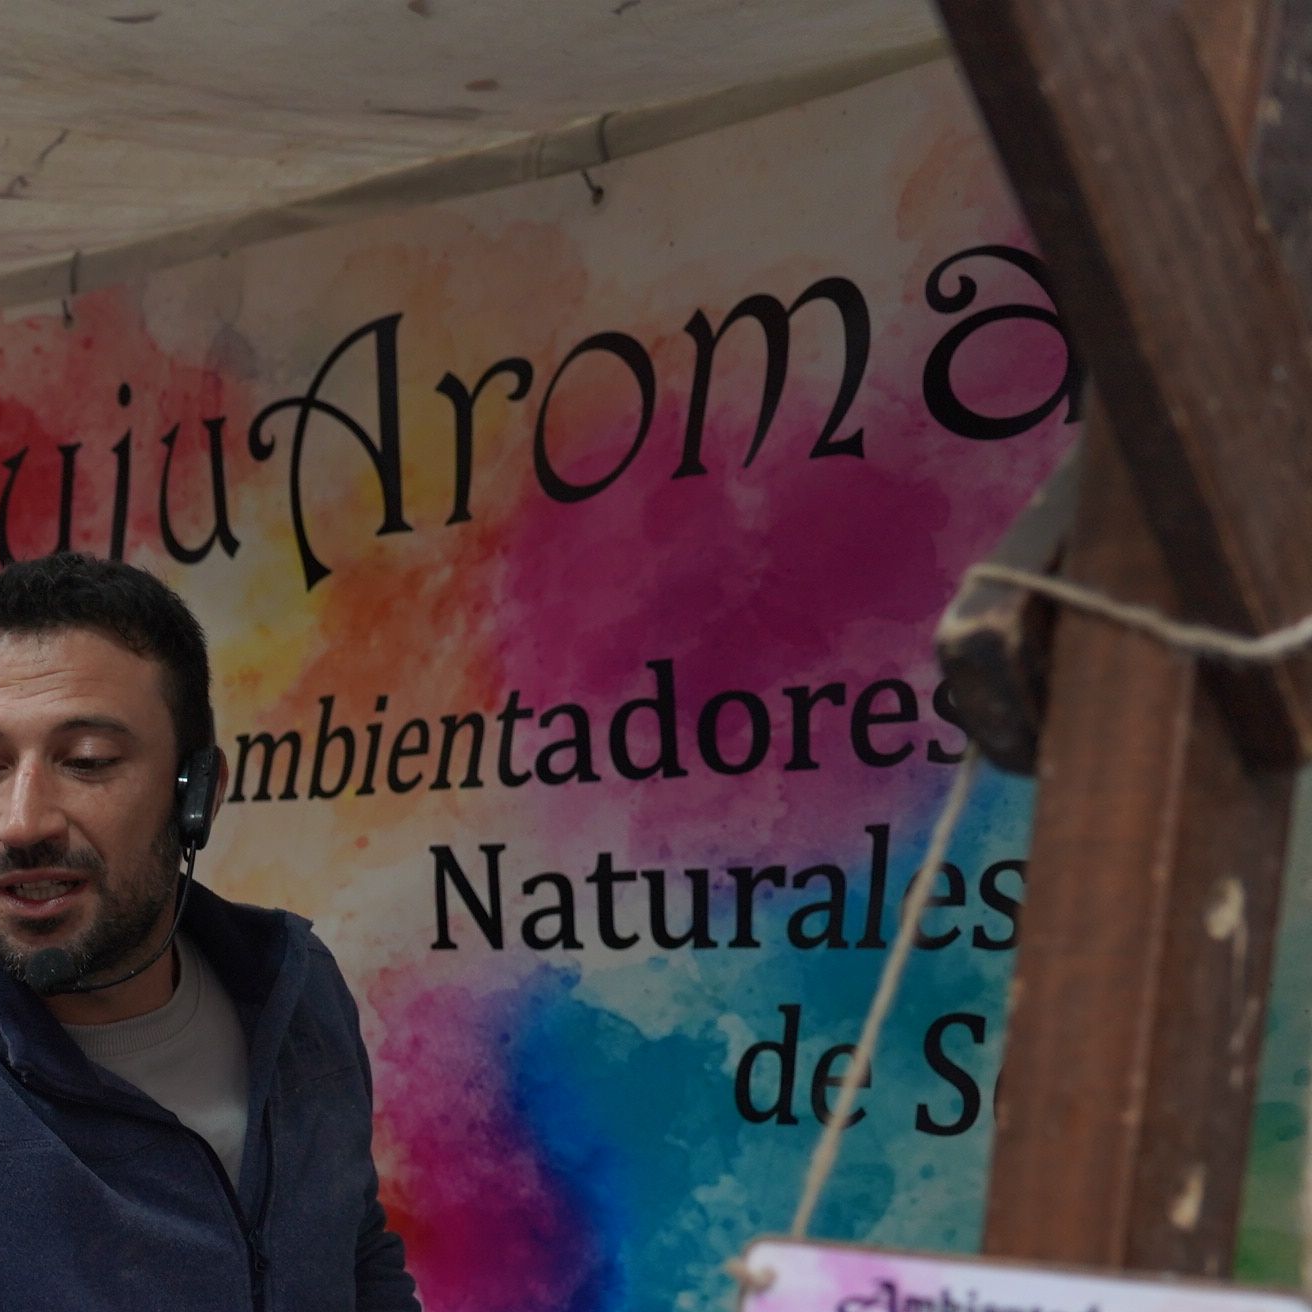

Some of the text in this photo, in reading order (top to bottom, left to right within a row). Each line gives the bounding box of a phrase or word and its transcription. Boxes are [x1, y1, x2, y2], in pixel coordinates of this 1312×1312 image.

[228, 659, 970, 804] mbientadores
[429, 823, 1032, 952] Naturales
[734, 1005, 1008, 1137] de S
